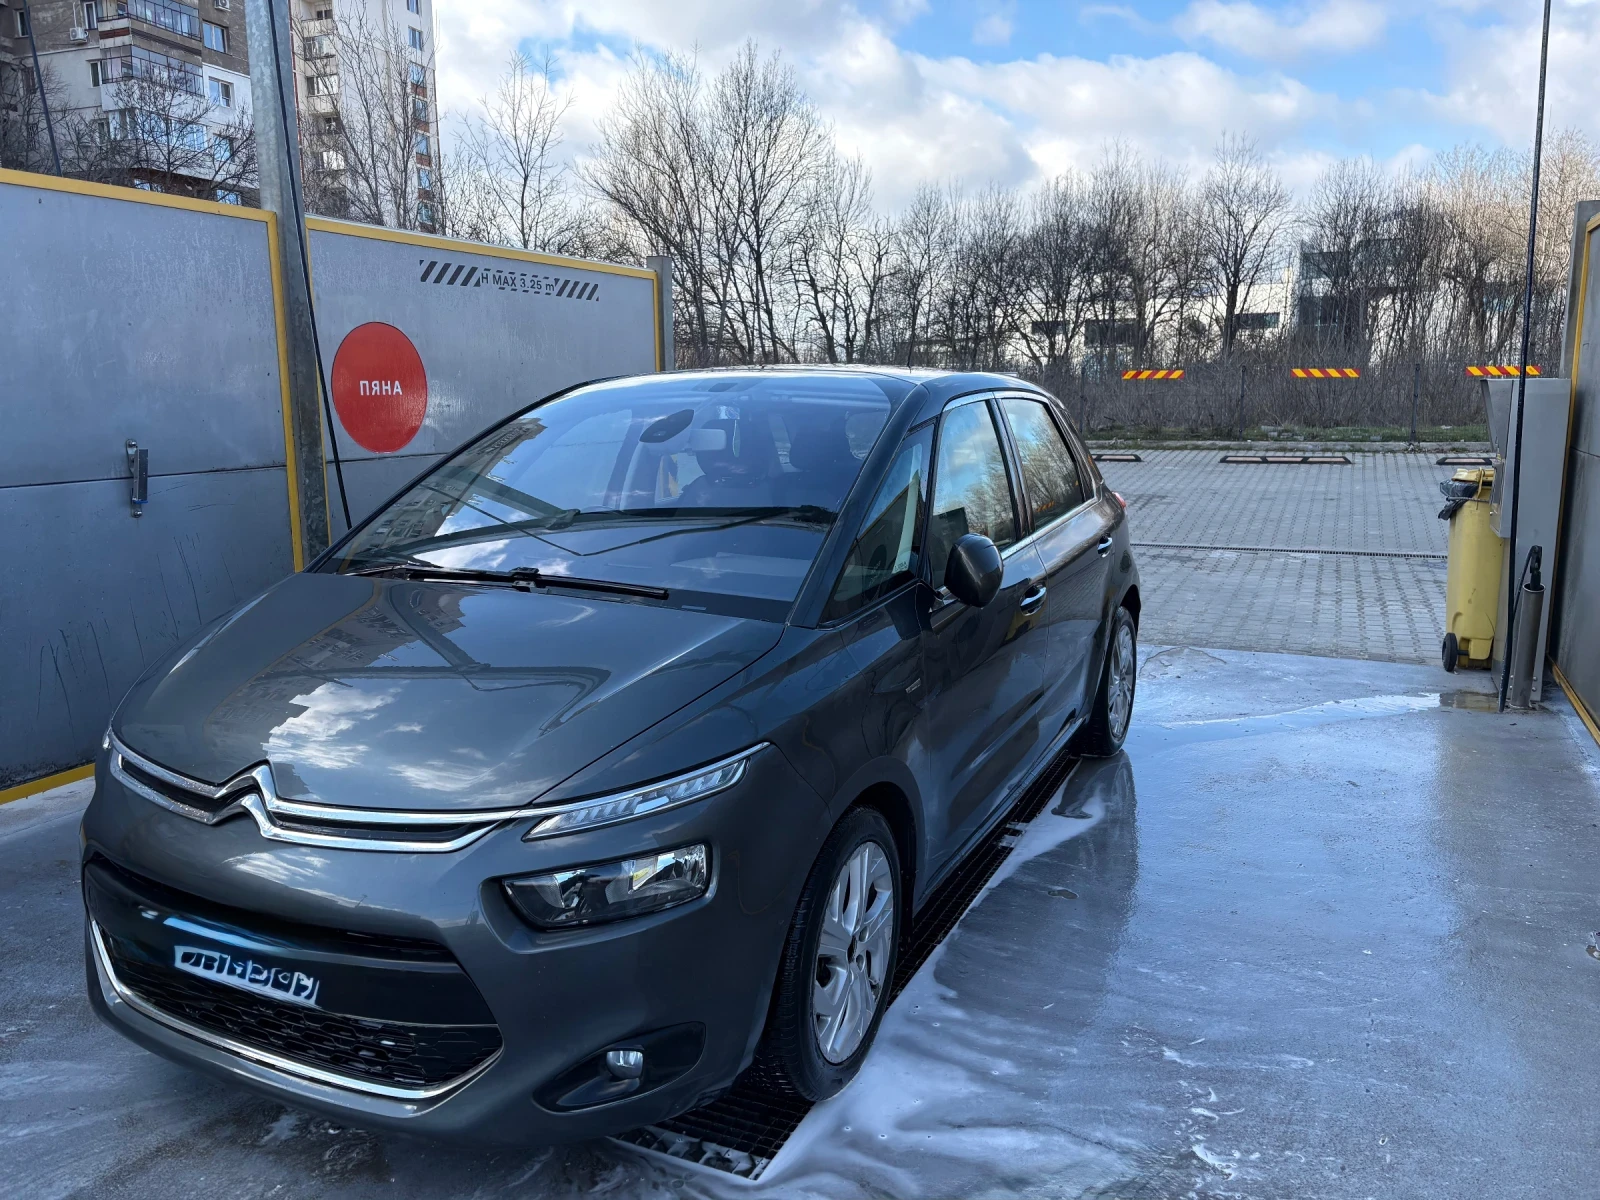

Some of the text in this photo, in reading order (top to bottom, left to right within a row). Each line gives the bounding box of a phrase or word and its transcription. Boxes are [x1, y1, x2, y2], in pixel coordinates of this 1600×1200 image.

[481, 272, 555, 292] H MAX 3.25 m
[359, 380, 403, 396] ПЯНА
